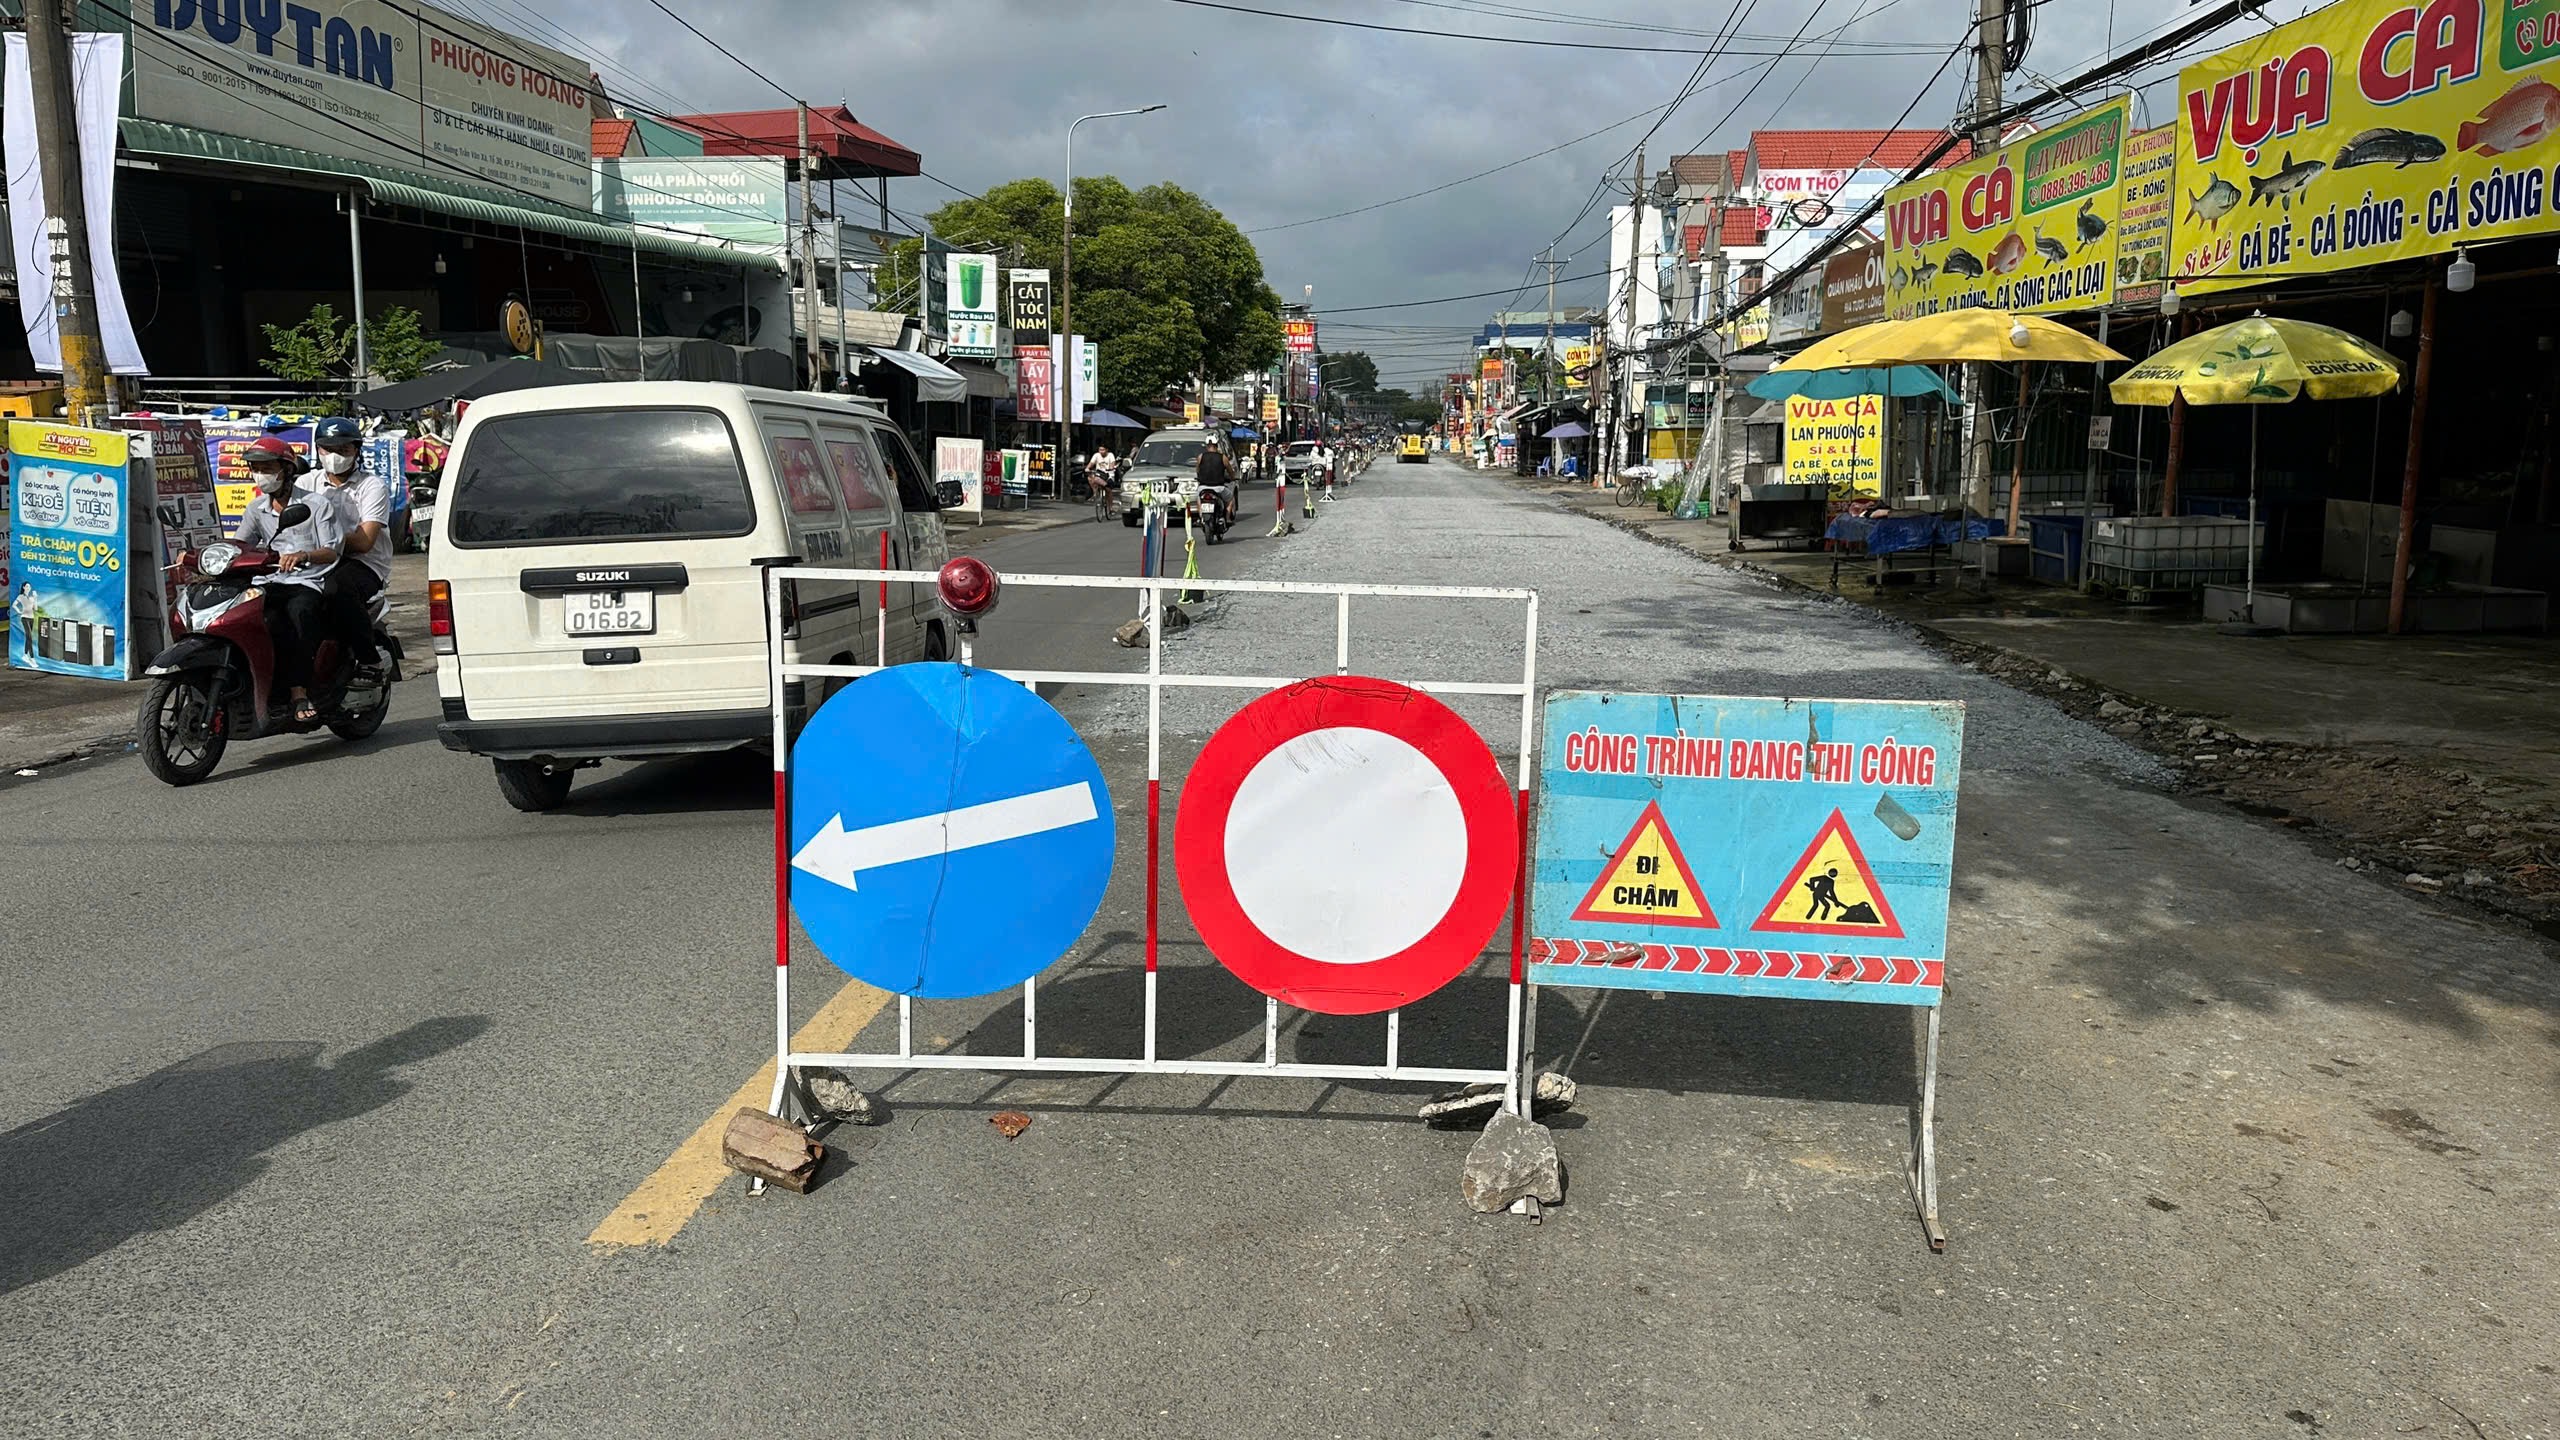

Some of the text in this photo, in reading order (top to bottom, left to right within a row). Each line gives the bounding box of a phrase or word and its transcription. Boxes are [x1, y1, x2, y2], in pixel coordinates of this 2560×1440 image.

[430, 37, 515, 87] PHƯỢNG
[247, 63, 323, 90] www.duytan.com
[177, 65, 194, 77] ISO
[202, 71, 246, 90] 9001:2015
[324, 100, 339, 112] ISO
[471, 101, 504, 121] CHUYÊN
[505, 111, 526, 126] KINH
[2186, 44, 2333, 167] VỰA
[445, 114, 451, 126] &
[552, 143, 566, 156] GIA
[566, 146, 587, 163] DỤNG
[2126, 130, 2173, 158] LAN PHƯƠNG
[2028, 116, 2119, 181] LAN PHƯƠNG 4
[632, 168, 746, 188] NHÀ PHÂN PHỐI
[1764, 171, 1840, 191] CƠM THỐ
[2040, 159, 2111, 204] 0888.396.488
[2142, 176, 2166, 199] ĐỒNG
[615, 189, 766, 207] SUNHOUSE ĐỒNG NAI
[1888, 152, 2015, 260] VỰA CÁ
[2199, 243, 2213, 270] &
[2238, 222, 2263, 272] CÁ
[2267, 214, 2291, 266] BÈ
[2310, 203, 2337, 258] CÁ
[2343, 190, 2405, 251] ĐỒNG
[2426, 175, 2460, 236] CÁ
[2467, 166, 2545, 229] SÔNG
[1018, 283, 1044, 300] CẮT
[1827, 278, 1845, 298] QUÁN
[1845, 272, 1864, 295] NHẬU
[1996, 279, 2011, 311] CÁ
[2014, 273, 2046, 310] SÔNG
[2047, 269, 2073, 300] CÁC
[2074, 260, 2107, 302] LOẠI
[1018, 300, 1045, 316] TÓC
[1867, 293, 1882, 309] LÒNG
[949, 311, 969, 320] Nước
[970, 312, 983, 320] Rau
[1016, 318, 1047, 330] NAM
[2127, 369, 2185, 380] BONCHA
[2306, 361, 2379, 375] BONCHA
[1021, 381, 1046, 396] RÁY
[1022, 398, 1046, 411] TAI
[1791, 396, 1877, 422] VỰA CÁ
[58, 435, 91, 447] NGUYÊN
[206, 429, 229, 437] XANH
[1791, 423, 1876, 441] LAN PHƯƠNG 4
[165, 443, 185, 455] BÁN
[1827, 446, 1837, 455] &
[1793, 458, 1806, 469] CÁ
[1831, 458, 1844, 468] CÁ
[229, 470, 248, 479] MÁY
[43, 483, 60, 491] nước
[81, 488, 99, 498] nóng
[99, 489, 115, 499] lạnh
[24, 509, 60, 522] VÔ CÙNG
[76, 498, 112, 518] TIỆN
[73, 516, 110, 529] VÔ CÙNG
[20, 533, 42, 548] TRẢ
[42, 537, 77, 554] CHẬM
[20, 548, 38, 560] ĐẾN
[38, 552, 47, 562] 12
[47, 553, 76, 566] THÁNG
[77, 540, 120, 571] 0%
[27, 564, 52, 578] không
[576, 571, 630, 582] SUZUKI
[573, 611, 642, 630] 016.82
[1565, 724, 1937, 787] CÔNG TRÌNH ĐANG THI CÔNG
[1636, 855, 1660, 876] ĐI
[1613, 883, 1679, 911] CHẬM
